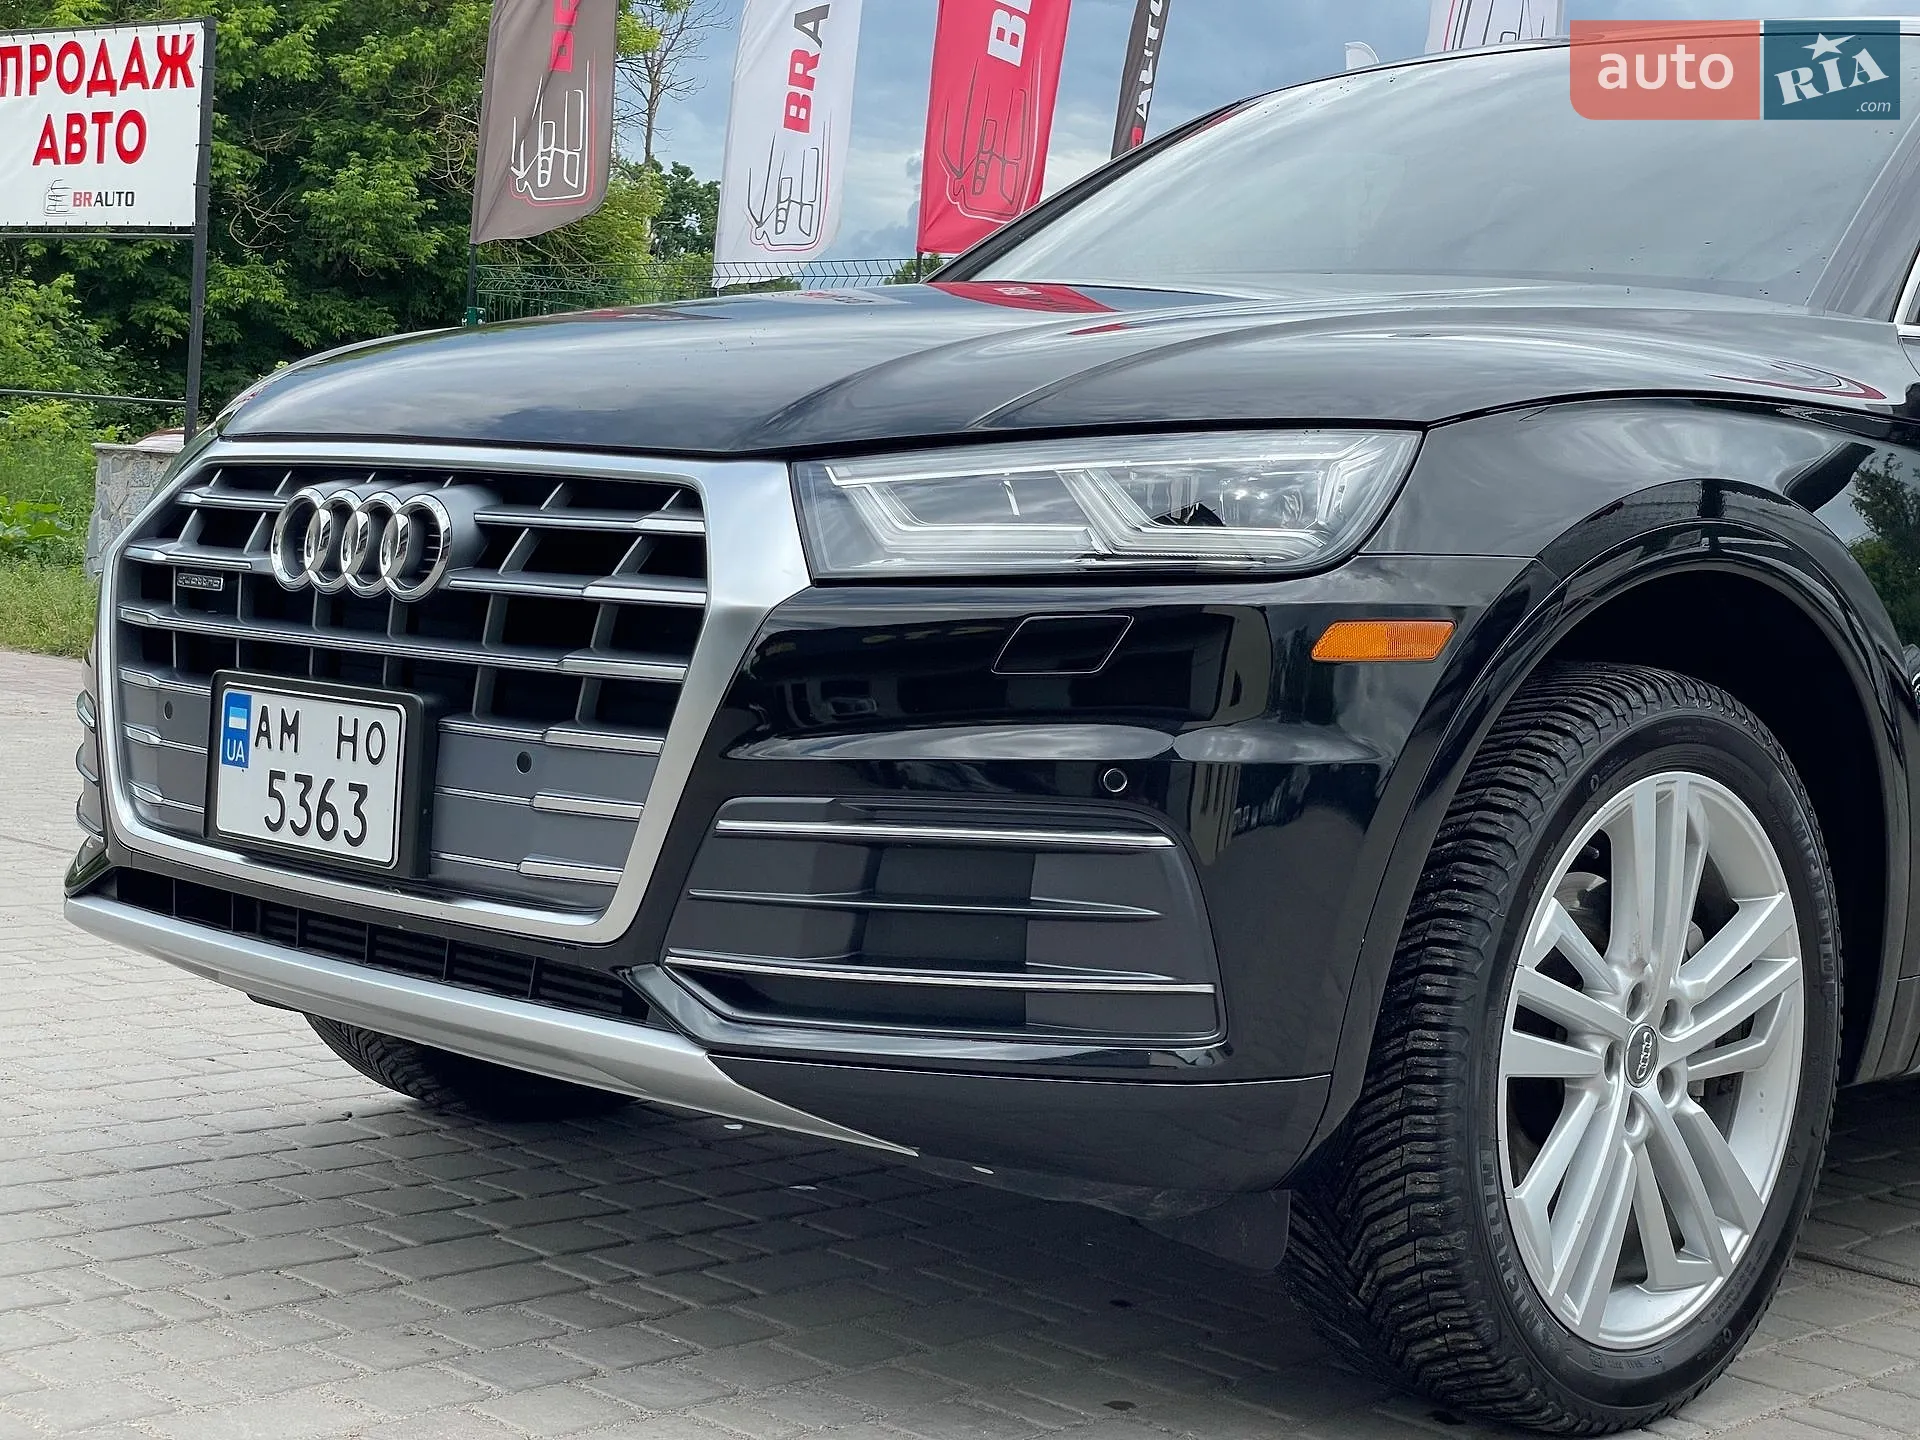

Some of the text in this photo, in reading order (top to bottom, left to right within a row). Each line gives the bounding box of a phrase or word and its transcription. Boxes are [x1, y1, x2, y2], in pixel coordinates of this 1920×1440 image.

[0, 34, 196, 98] ПРОДАЖ
[783, 3, 831, 134] BRA
[32, 109, 147, 166] АВТО
[72, 191, 135, 208] BRAUTO
[226, 739, 245, 763] UA
[255, 706, 386, 766] AM HO
[264, 770, 369, 848] 5363
